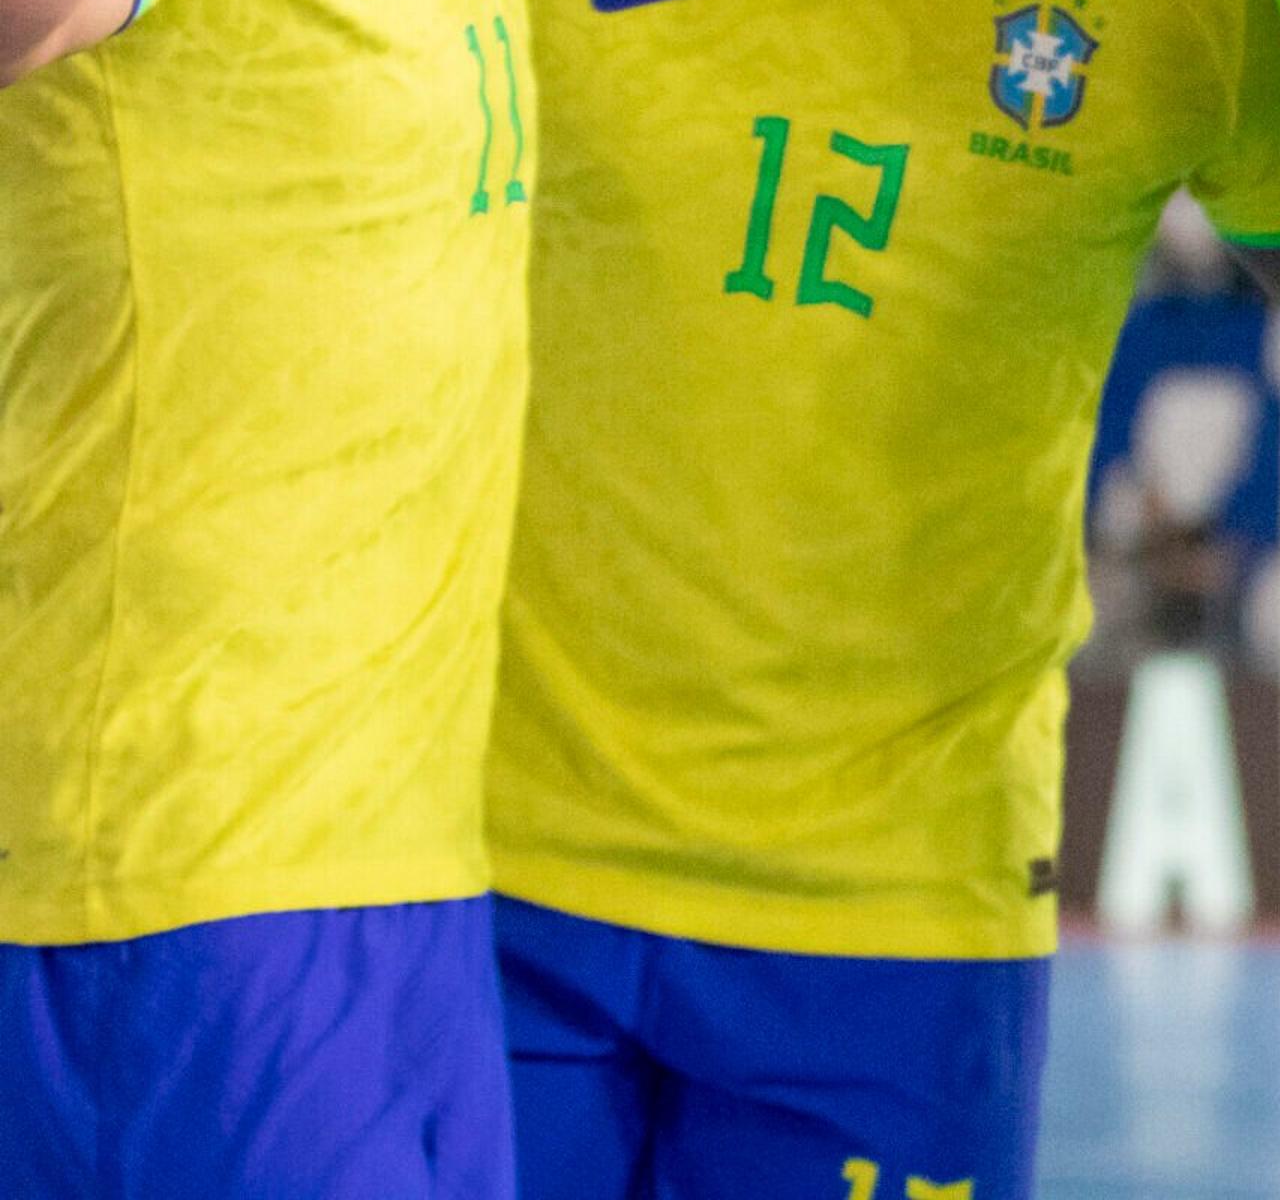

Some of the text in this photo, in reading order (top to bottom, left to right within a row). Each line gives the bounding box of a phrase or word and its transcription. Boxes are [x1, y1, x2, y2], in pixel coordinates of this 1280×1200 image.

[465, 15, 527, 215] 11
[1020, 52, 1060, 73] CBF
[968, 131, 1075, 177] BRASIL
[723, 115, 911, 319] 12
